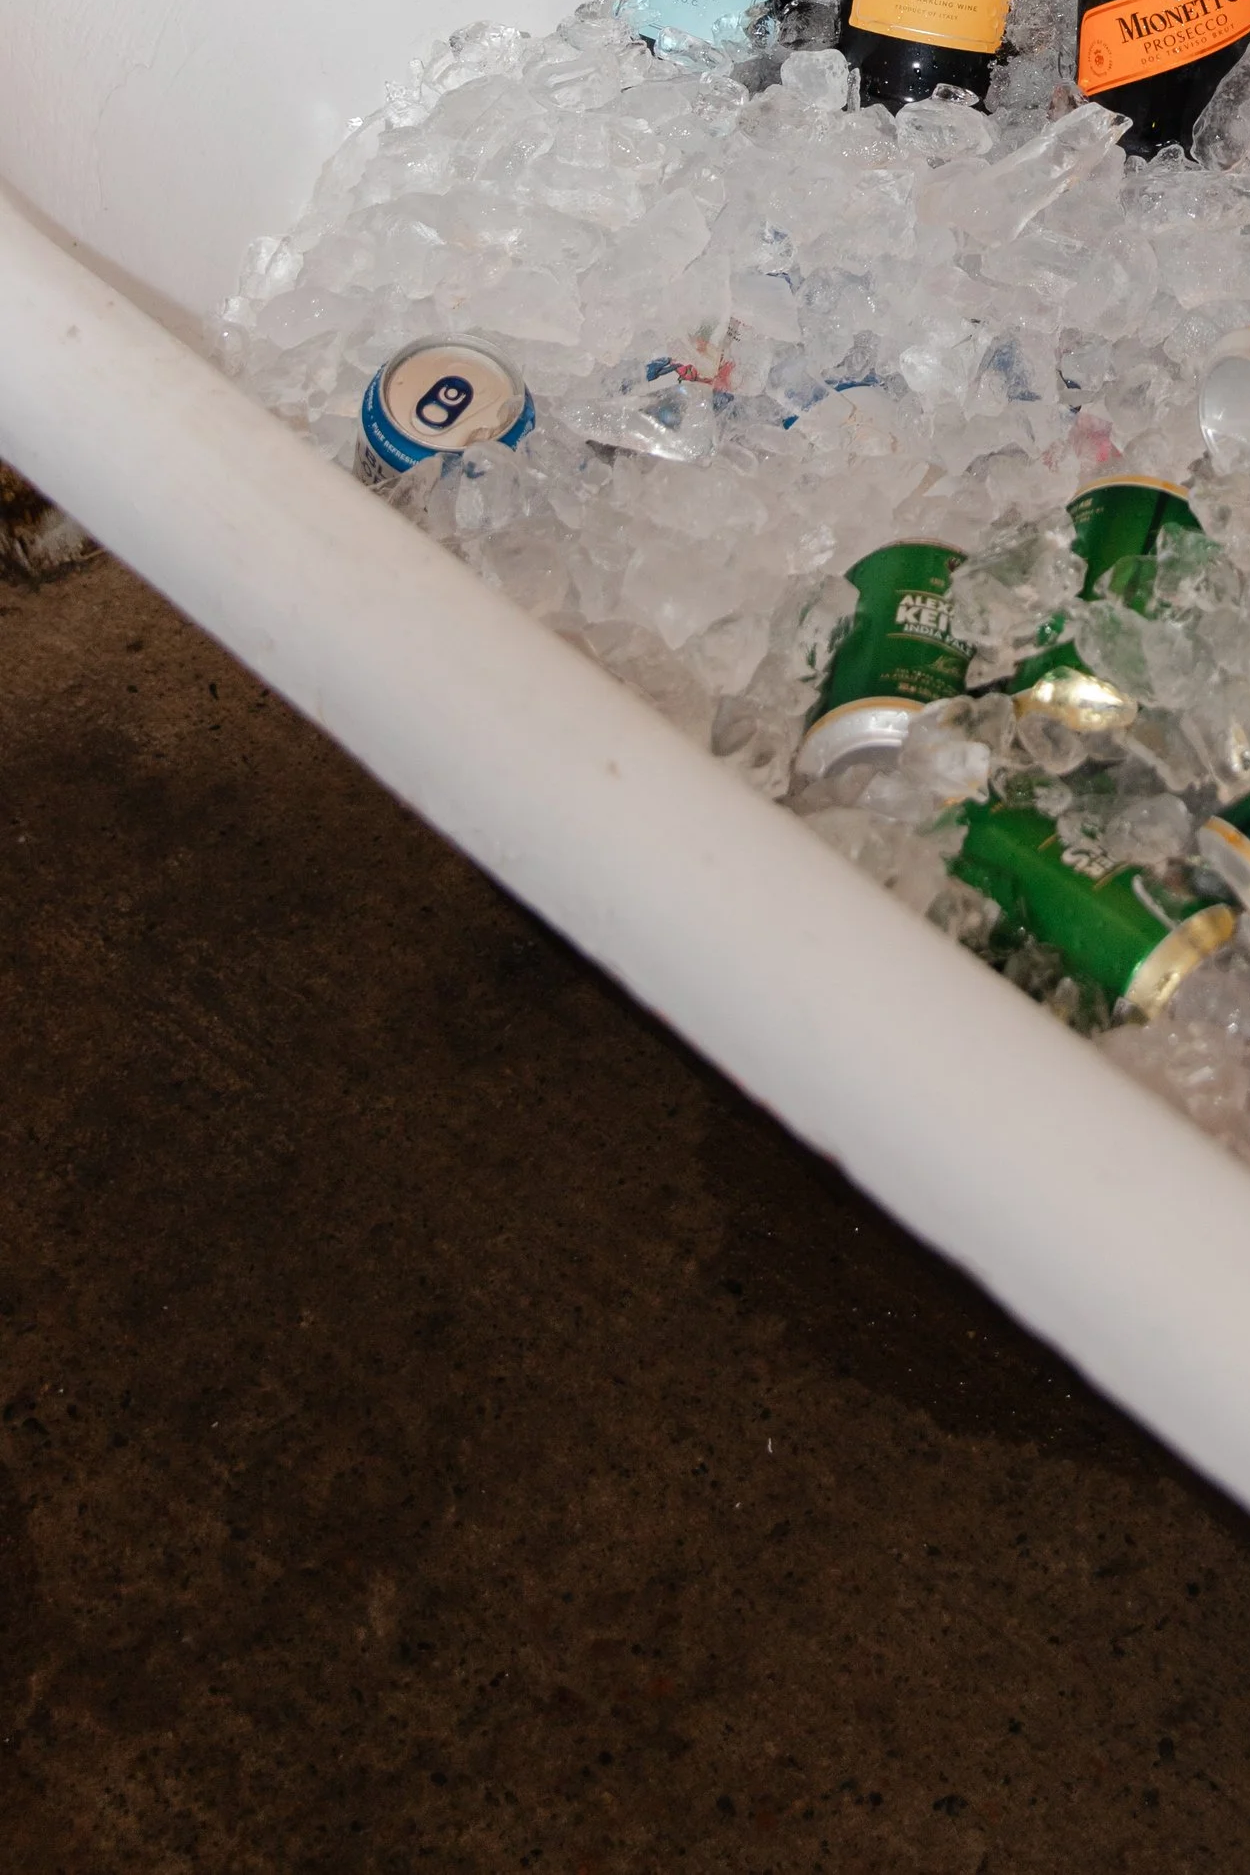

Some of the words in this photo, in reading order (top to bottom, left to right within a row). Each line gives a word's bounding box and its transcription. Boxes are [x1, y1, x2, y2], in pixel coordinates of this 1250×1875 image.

[894, 4, 926, 15] PRODUCT
[938, 12, 958, 21] ITALY
[956, 2, 978, 12] WINE
[1143, 13, 1228, 54] PROSECCO
[1141, 53, 1161, 65] DOC
[1166, 37, 1208, 56] TREVISO
[1212, 25, 1235, 39] BRUT
[372, 422, 386, 443] PURE
[904, 623, 943, 639] INDIA
